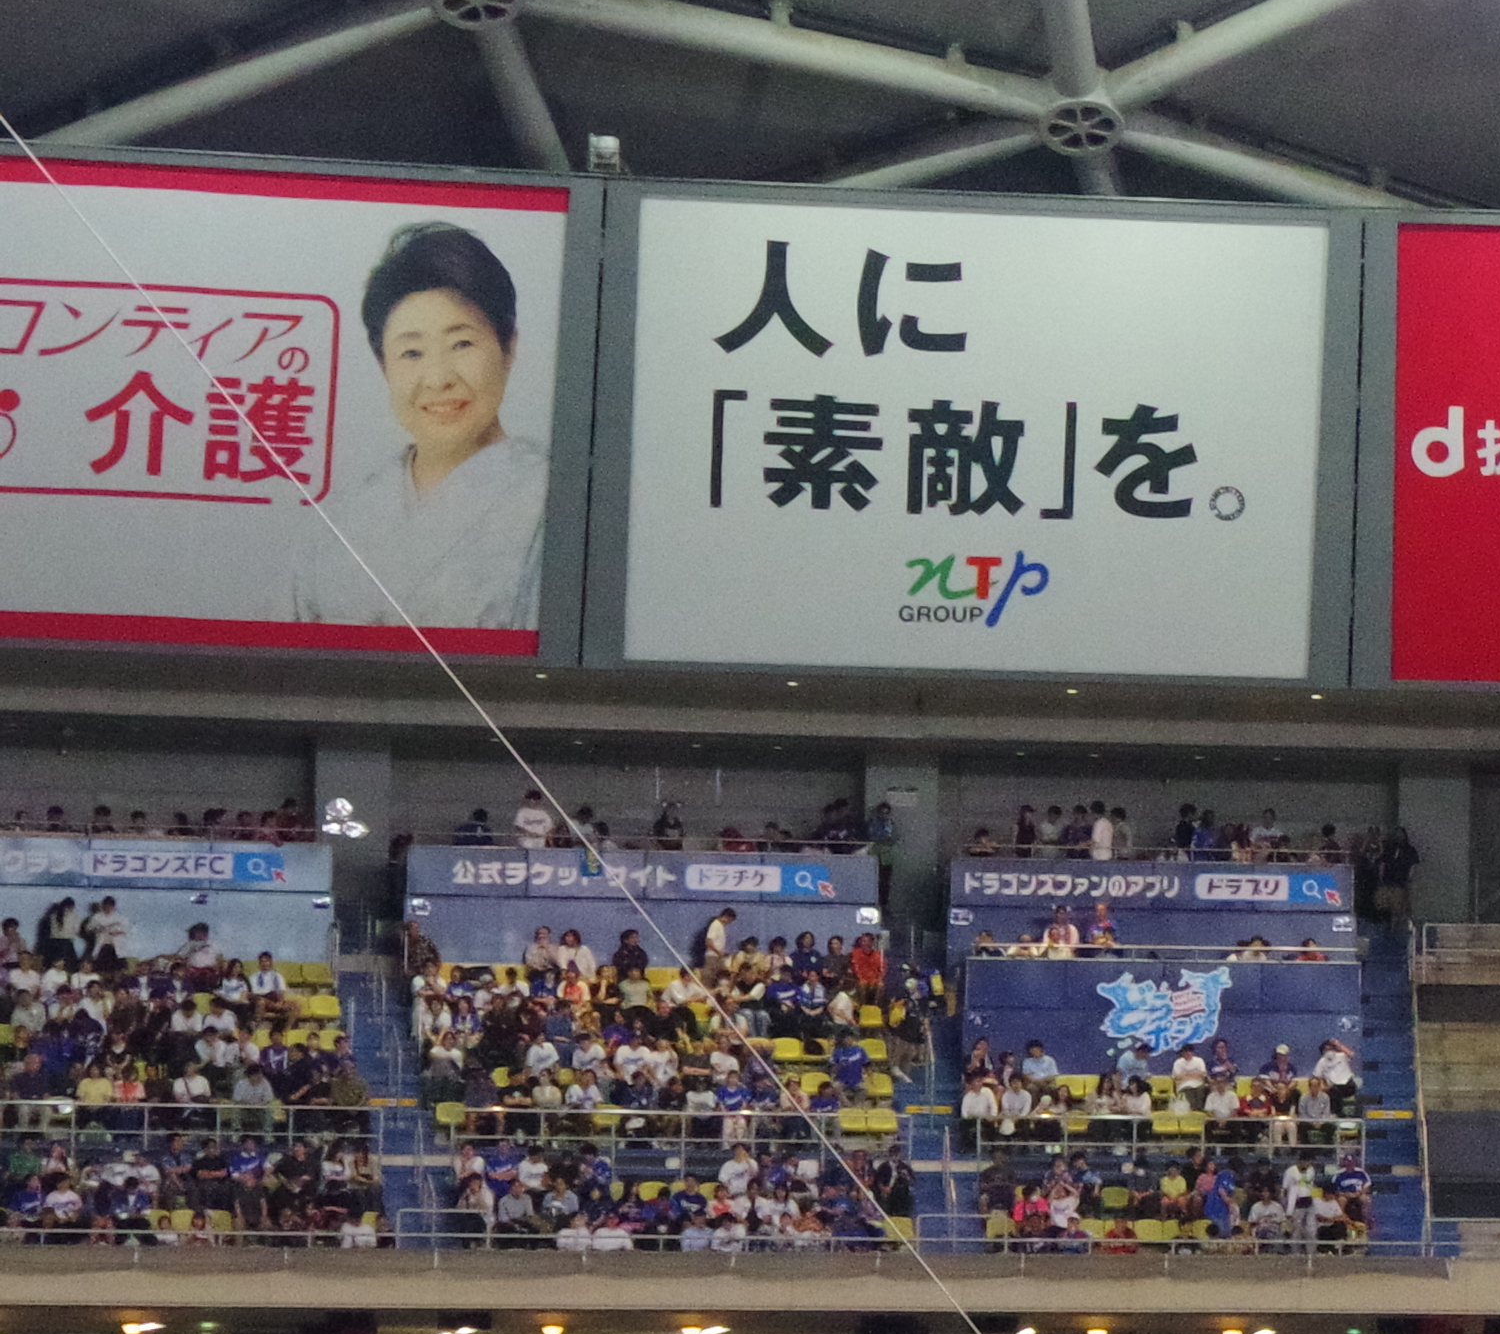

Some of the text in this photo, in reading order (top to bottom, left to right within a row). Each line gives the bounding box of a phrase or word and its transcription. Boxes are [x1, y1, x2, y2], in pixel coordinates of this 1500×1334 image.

[713, 240, 968, 357] 人に
[84, 370, 314, 484] 介護
[899, 605, 983, 623] GROUP
[92, 852, 225, 875] ドラゴンズFC
[963, 872, 1181, 898] ドラゴンズファンのアプリ
